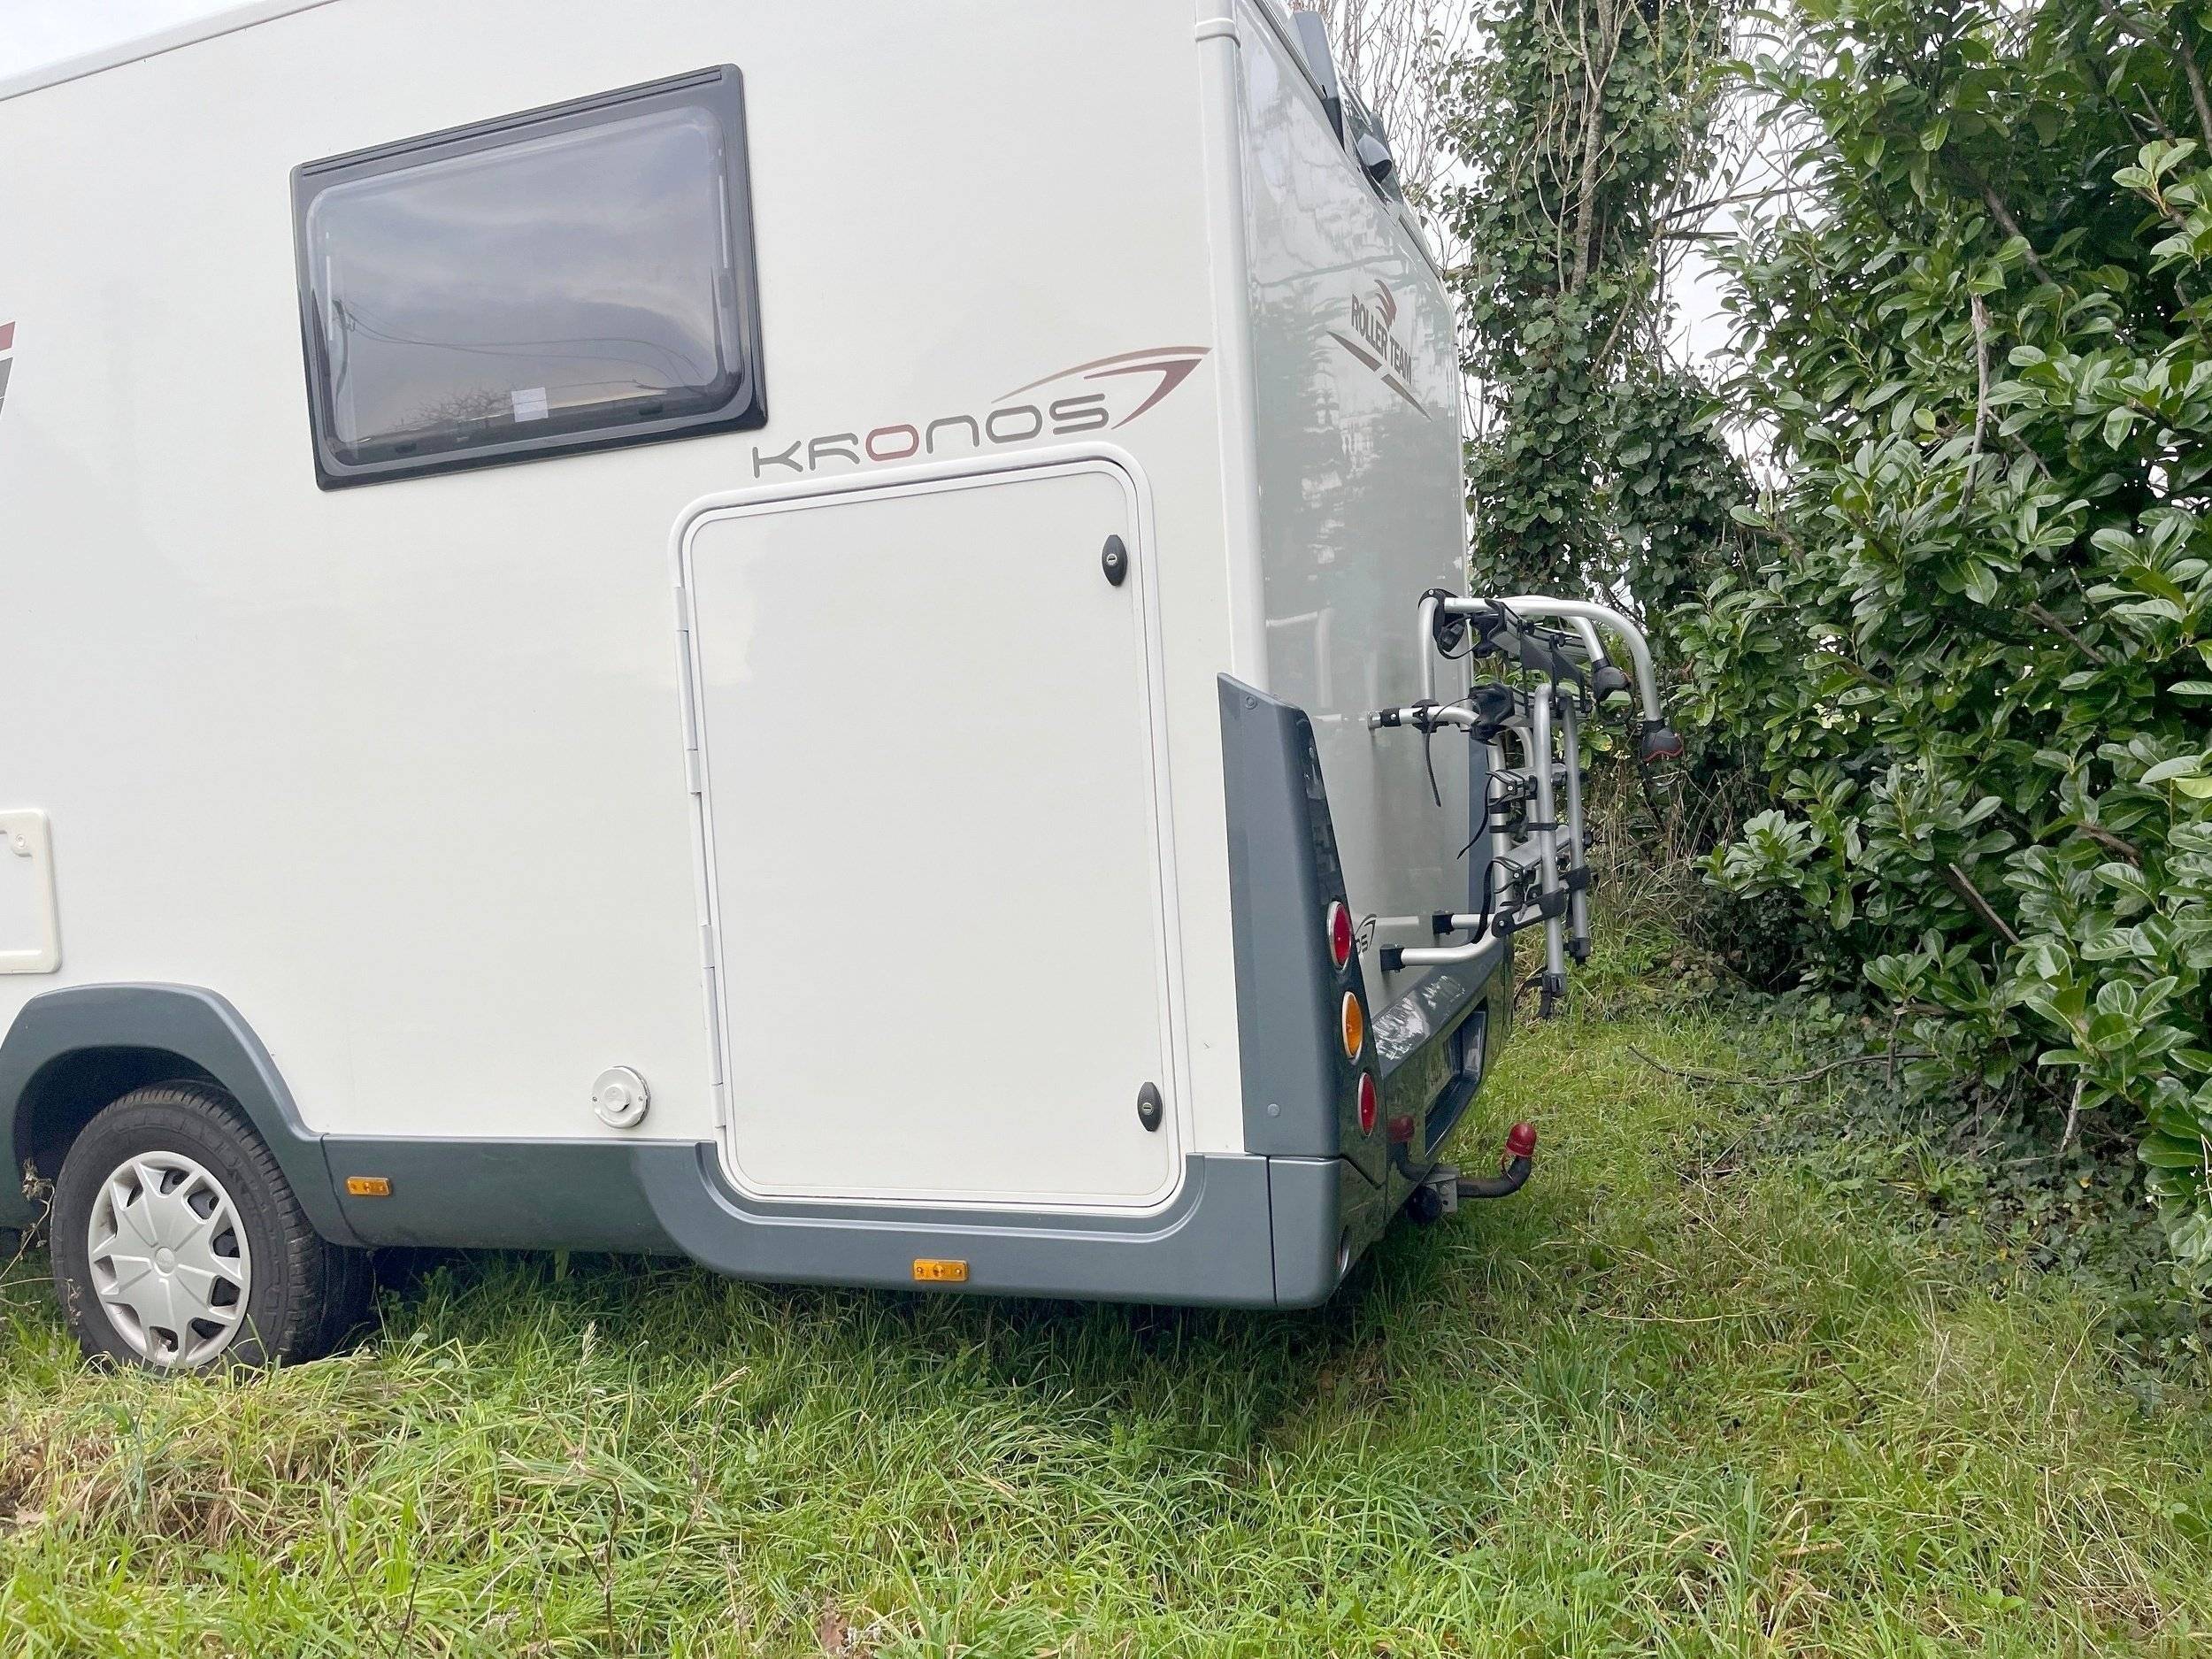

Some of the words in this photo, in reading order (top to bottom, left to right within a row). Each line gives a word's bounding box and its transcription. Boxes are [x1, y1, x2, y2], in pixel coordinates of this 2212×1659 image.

[1351, 293, 1388, 362] ROLLER
[1389, 334, 1412, 385] TEAM
[752, 392, 1110, 479] KRONOS
